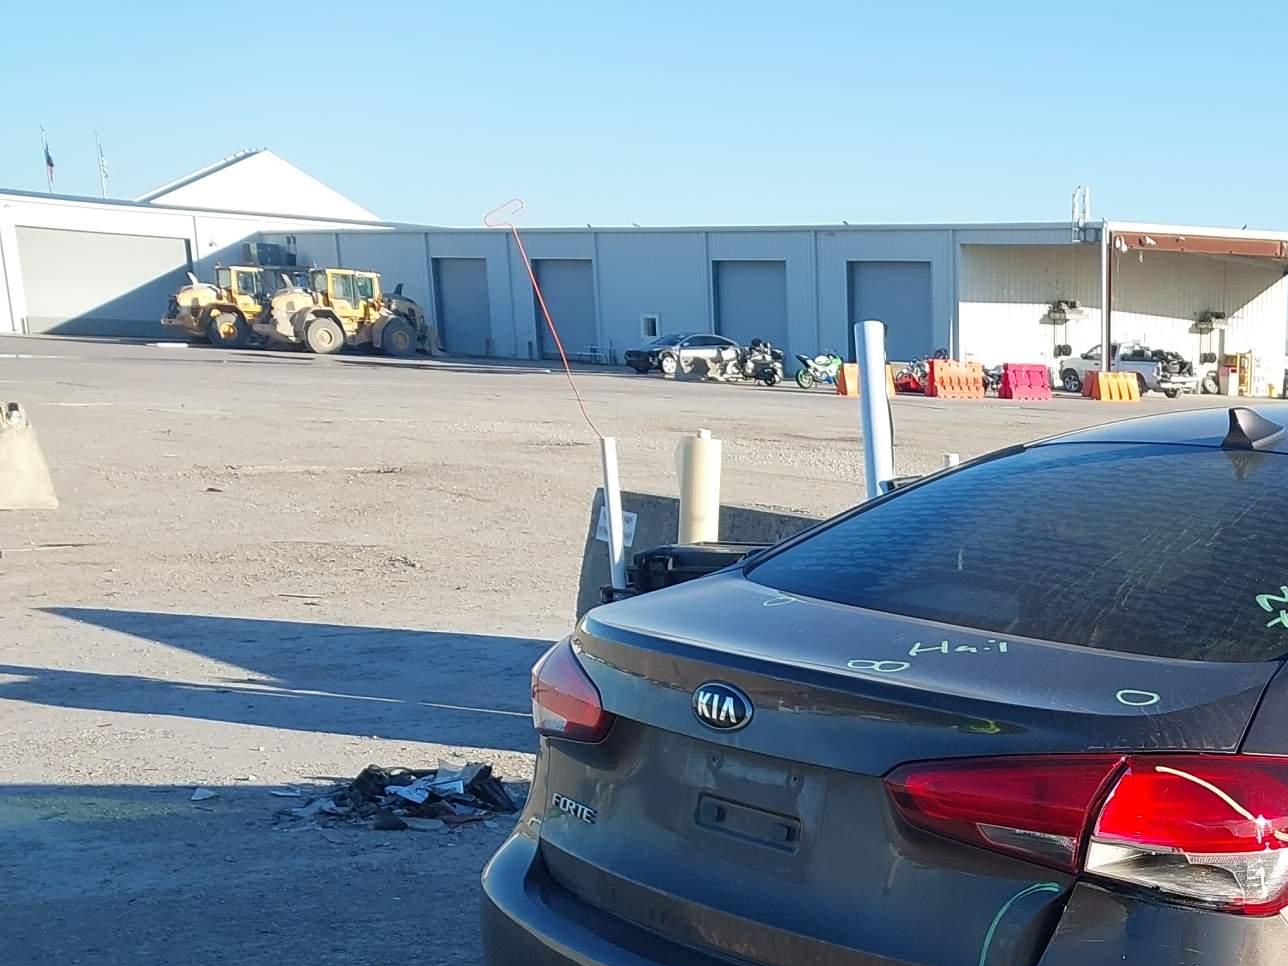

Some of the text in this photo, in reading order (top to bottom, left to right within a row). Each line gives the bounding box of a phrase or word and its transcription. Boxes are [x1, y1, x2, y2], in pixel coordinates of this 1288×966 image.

[908, 639, 1008, 657] Hail
[697, 690, 737, 724] KIA
[552, 792, 598, 824] FORTE
